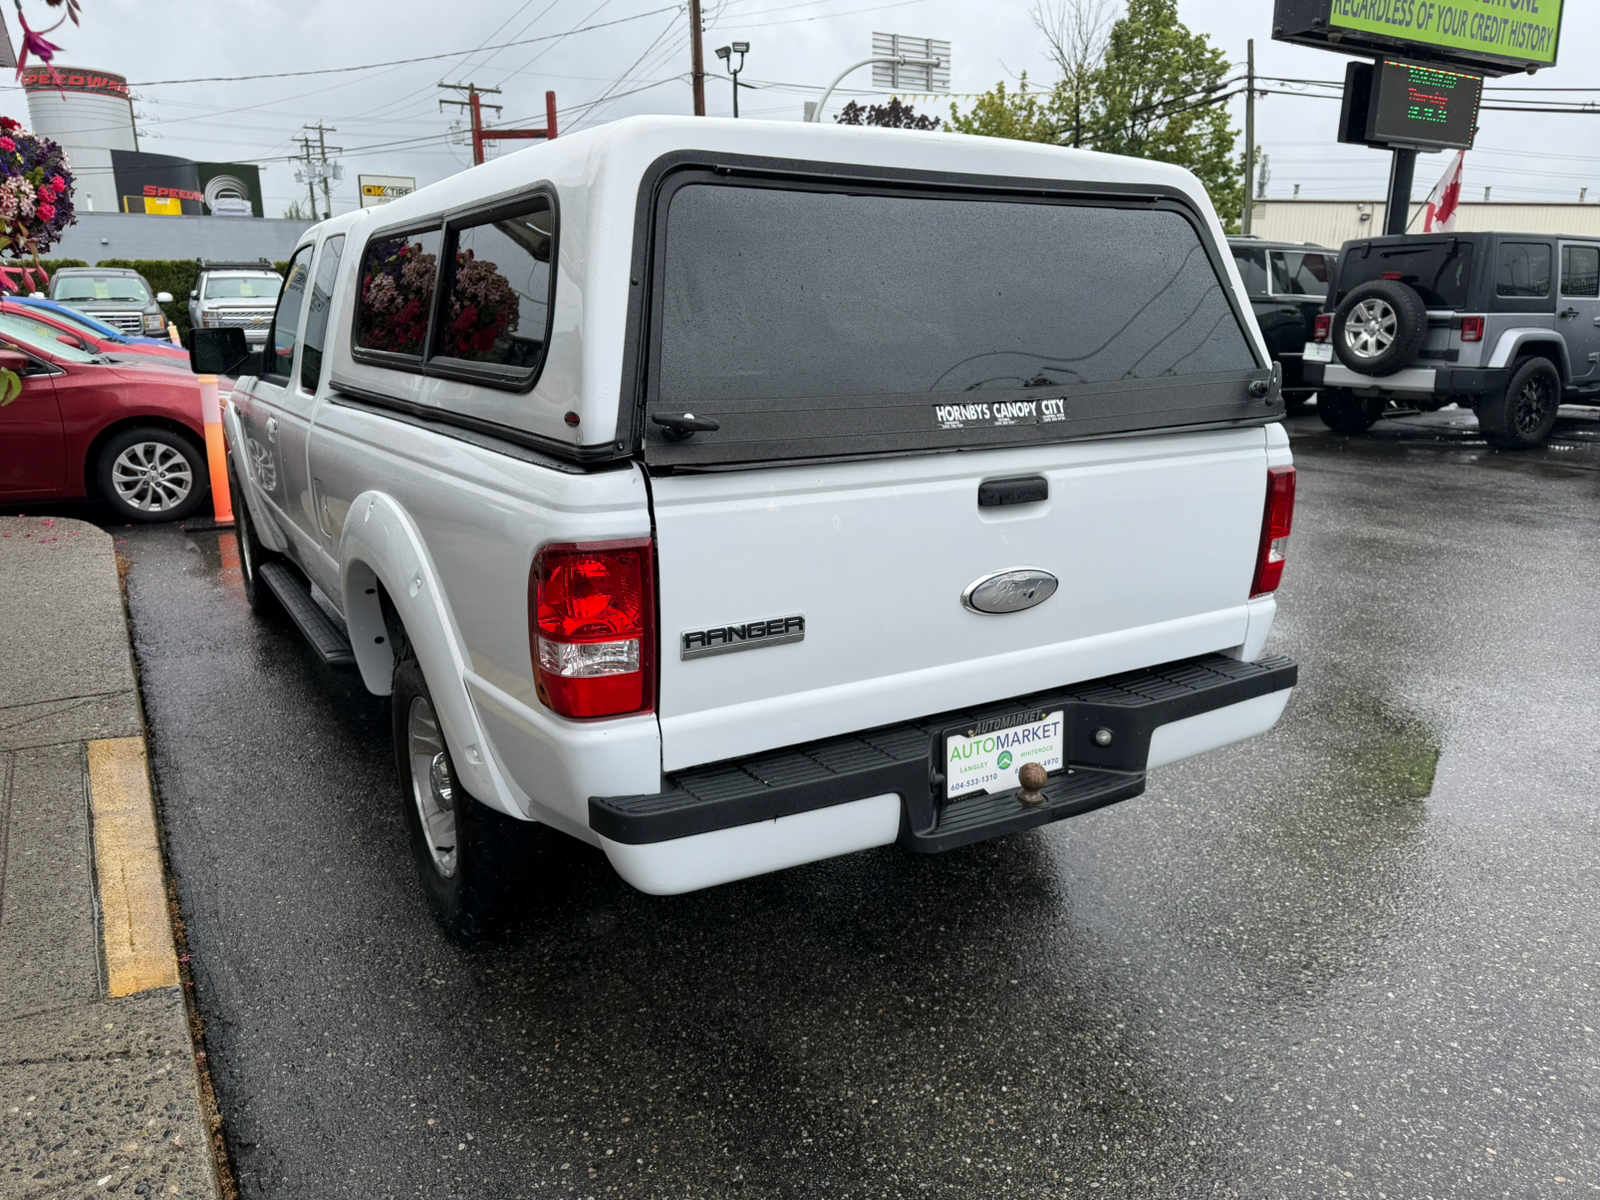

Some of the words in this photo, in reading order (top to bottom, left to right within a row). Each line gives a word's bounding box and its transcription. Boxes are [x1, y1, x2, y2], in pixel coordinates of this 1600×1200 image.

[1417, 1, 1434, 30] OF
[1436, 5, 1469, 38] YOUR
[1470, 12, 1509, 44] CREDIT
[1507, 20, 1554, 53] HISTORY
[363, 185, 386, 197] OK
[936, 403, 990, 422] HORNBYS
[992, 401, 1037, 418] CANOPY
[1041, 399, 1064, 415] CITY
[682, 615, 805, 649] RANGER
[974, 709, 1042, 735] AUTOMARKET
[949, 721, 1060, 762] AUTOMARKET
[1020, 745, 1054, 758] WHITEROCK
[959, 761, 988, 774] LANGLEY
[950, 773, 998, 791] 604-533-1310
